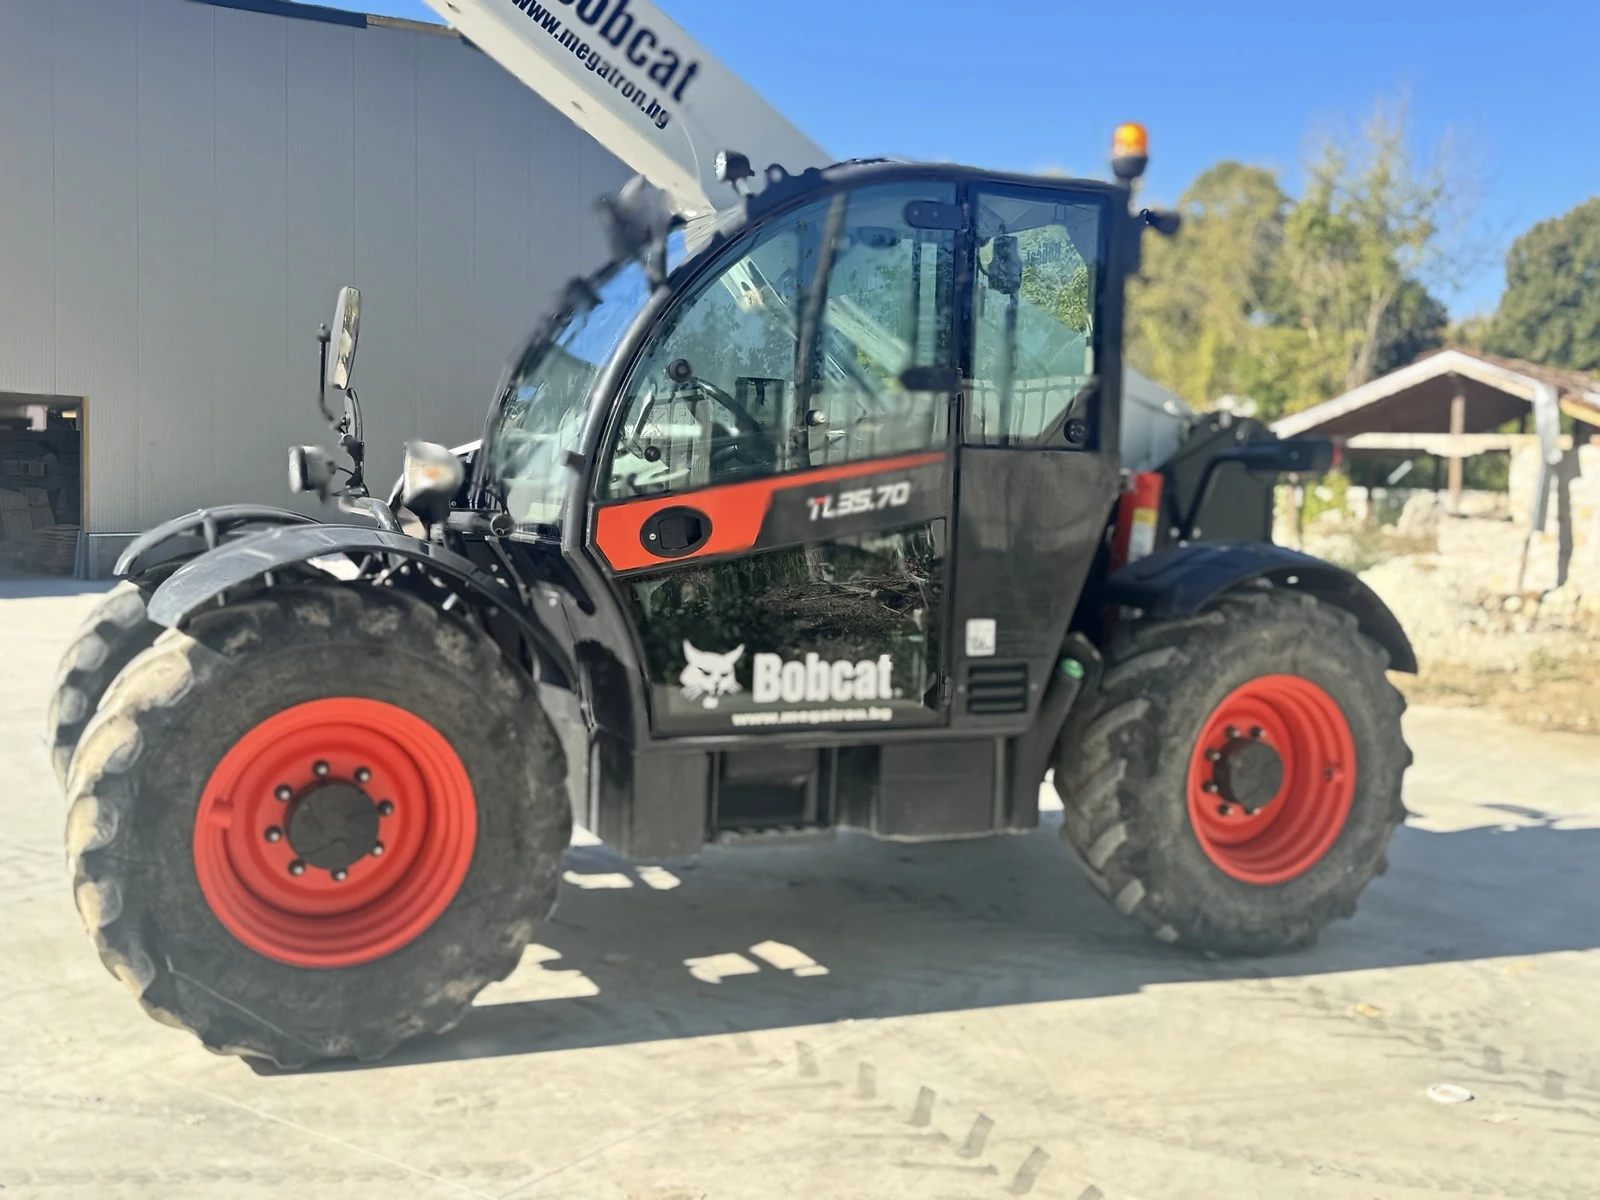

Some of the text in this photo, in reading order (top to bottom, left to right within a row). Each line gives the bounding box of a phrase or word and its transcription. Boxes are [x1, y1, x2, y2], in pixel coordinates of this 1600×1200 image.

[556, 0, 699, 103] obcat
[807, 482, 911, 521] TL35.70
[752, 652, 893, 703] Bobcat
